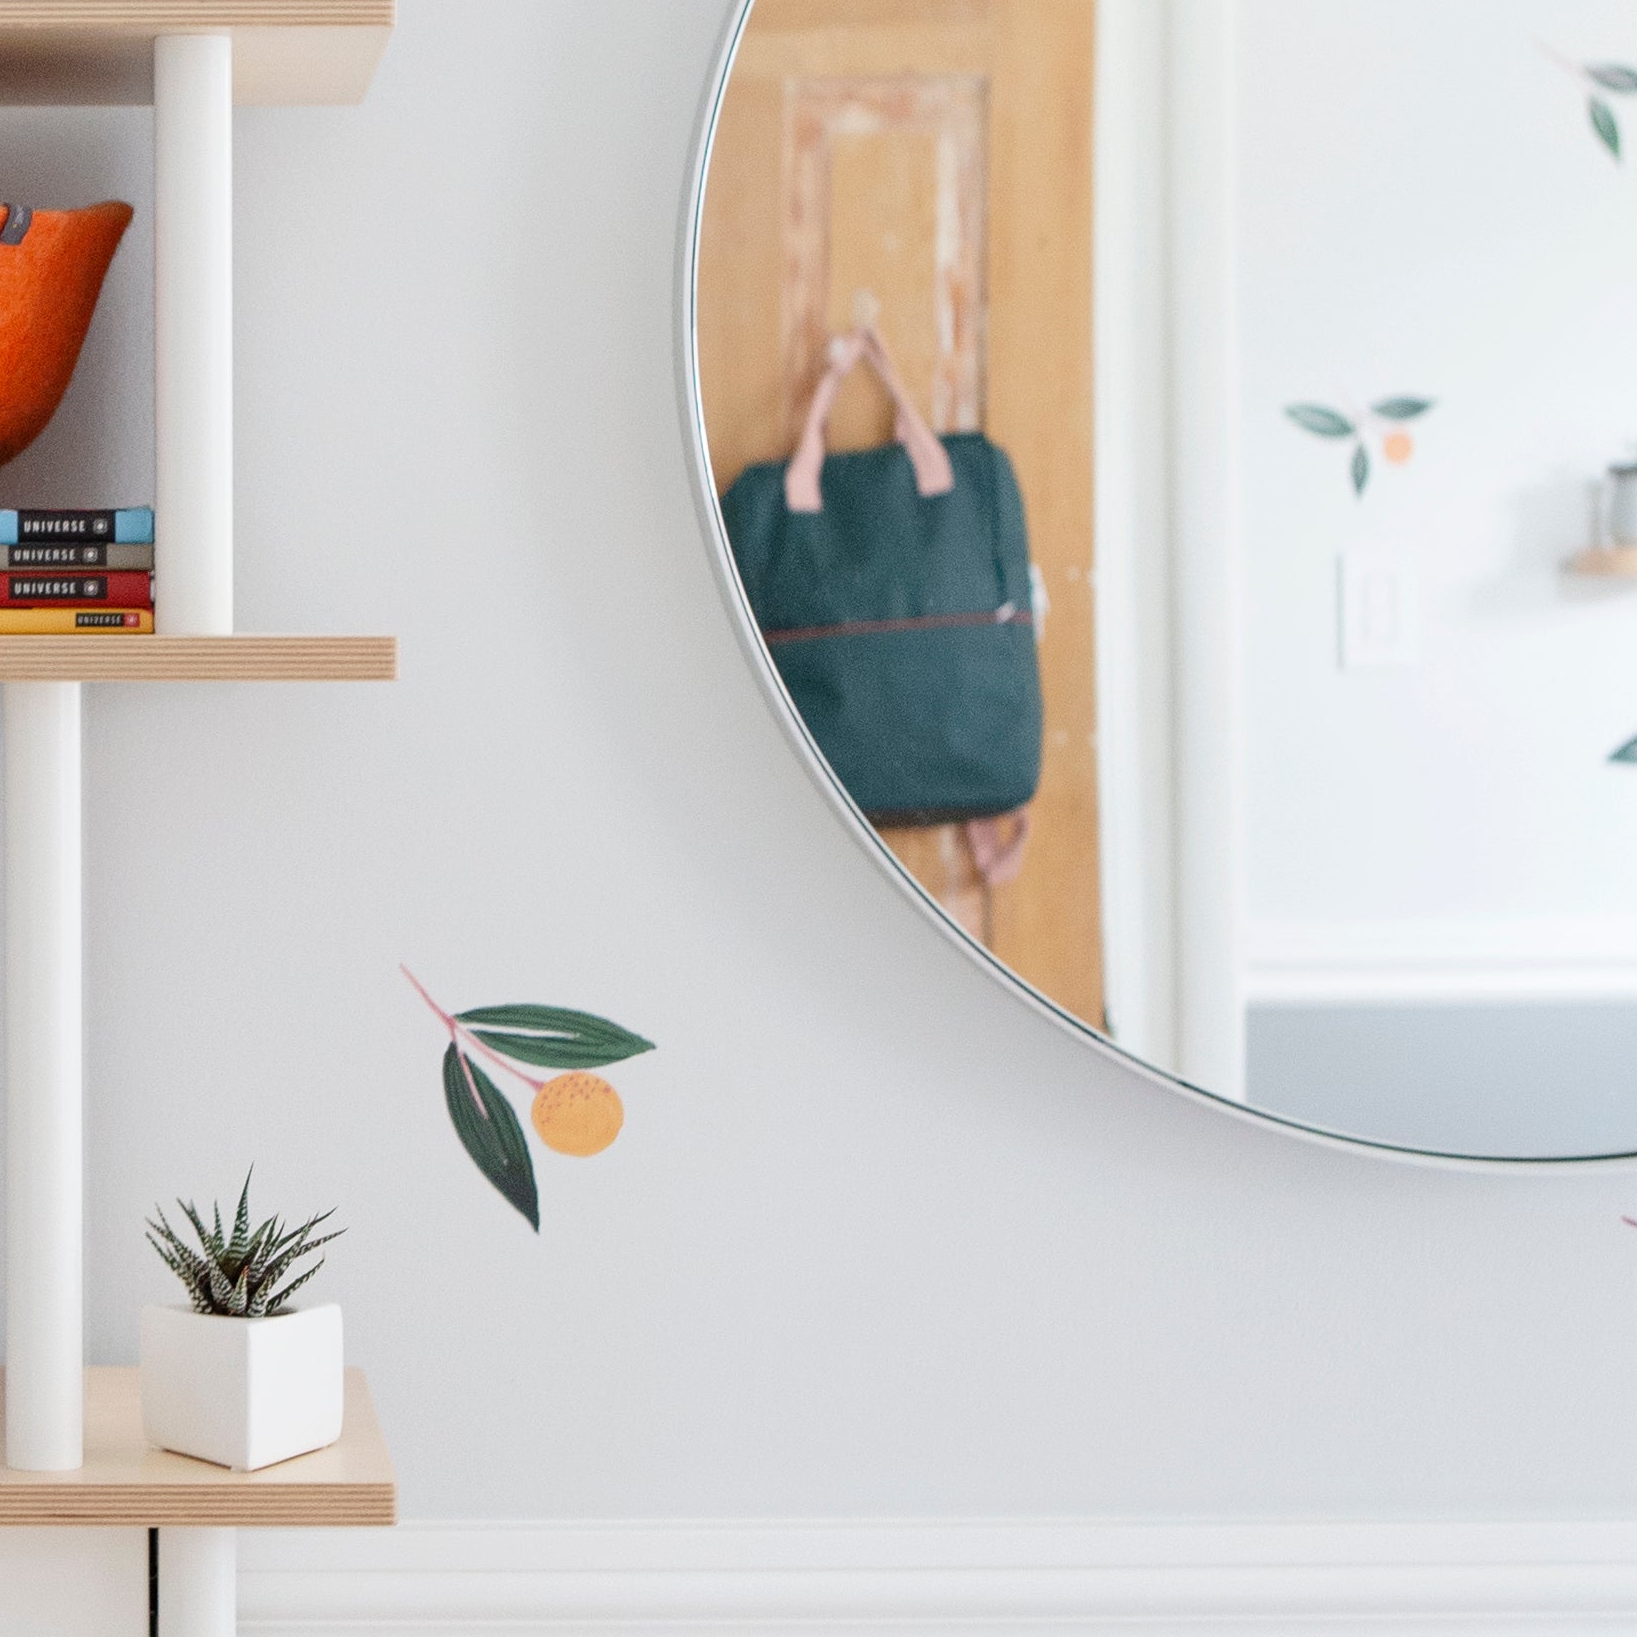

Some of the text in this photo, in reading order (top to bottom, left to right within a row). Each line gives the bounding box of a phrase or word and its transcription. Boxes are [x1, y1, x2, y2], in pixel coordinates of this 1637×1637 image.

[24, 520, 85, 533] UNIVERSE
[14, 549, 76, 561] UNIVERSE
[14, 581, 77, 594] UNIVERSE
[78, 614, 122, 624] UNIVERSE
